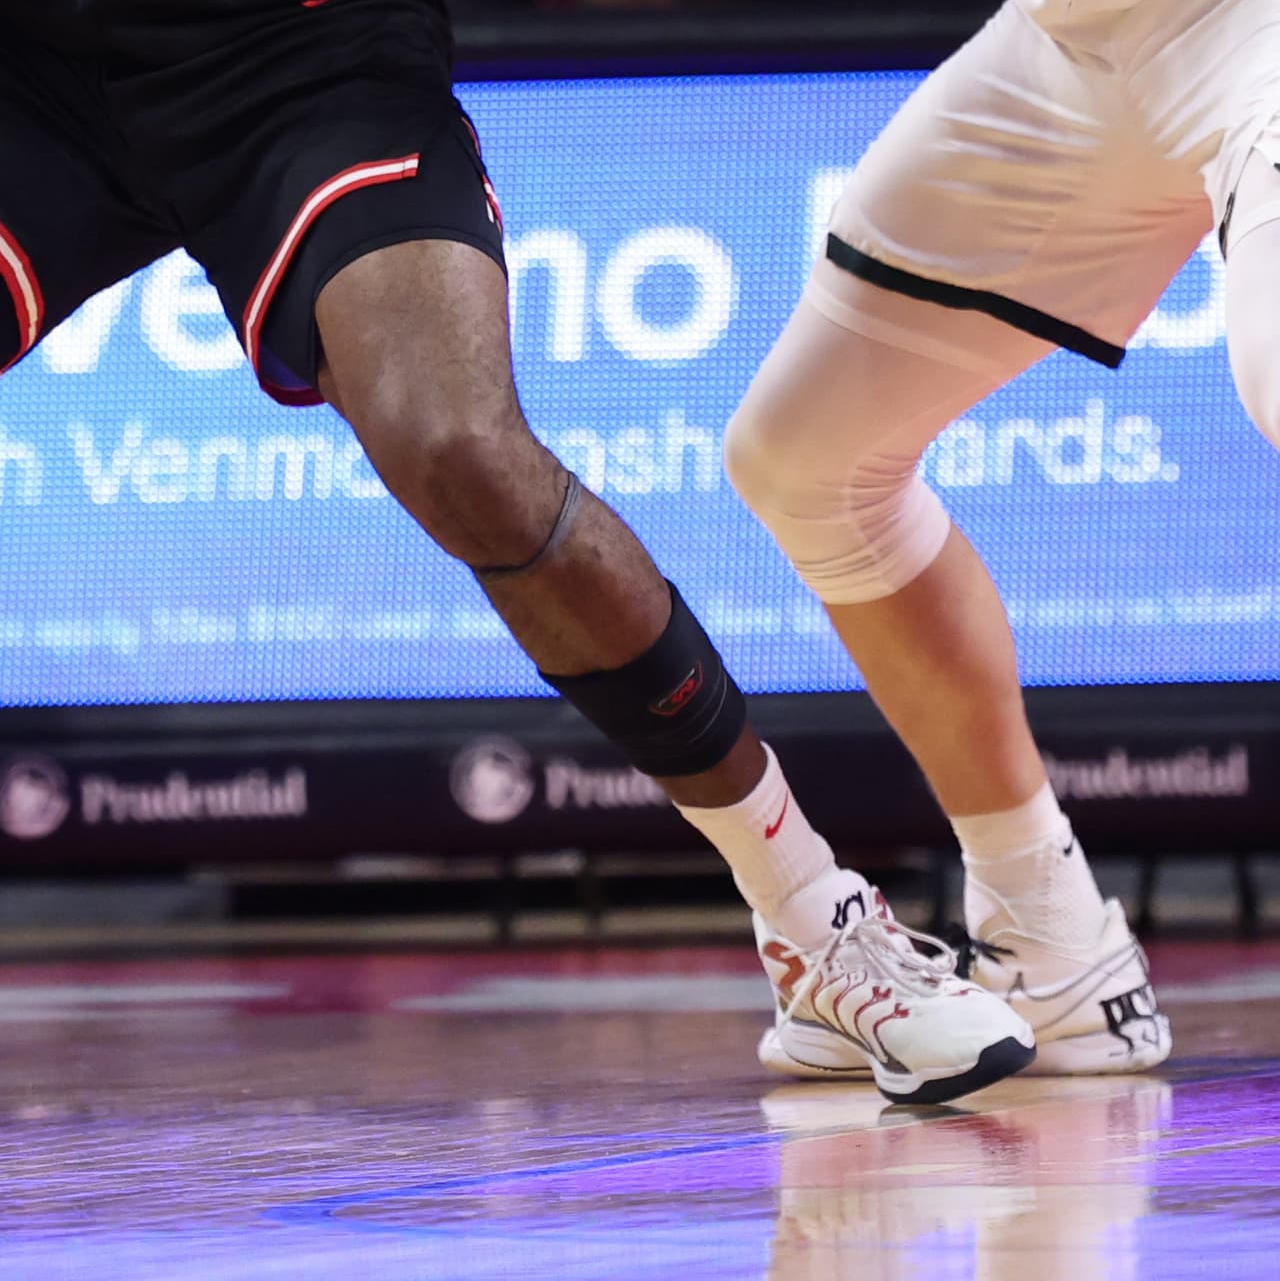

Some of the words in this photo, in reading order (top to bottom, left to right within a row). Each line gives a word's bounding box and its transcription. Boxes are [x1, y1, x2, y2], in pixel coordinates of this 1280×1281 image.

[532, 409, 716, 495] ash
[928, 397, 1181, 488] ards.
[80, 767, 308, 823] Prudential
